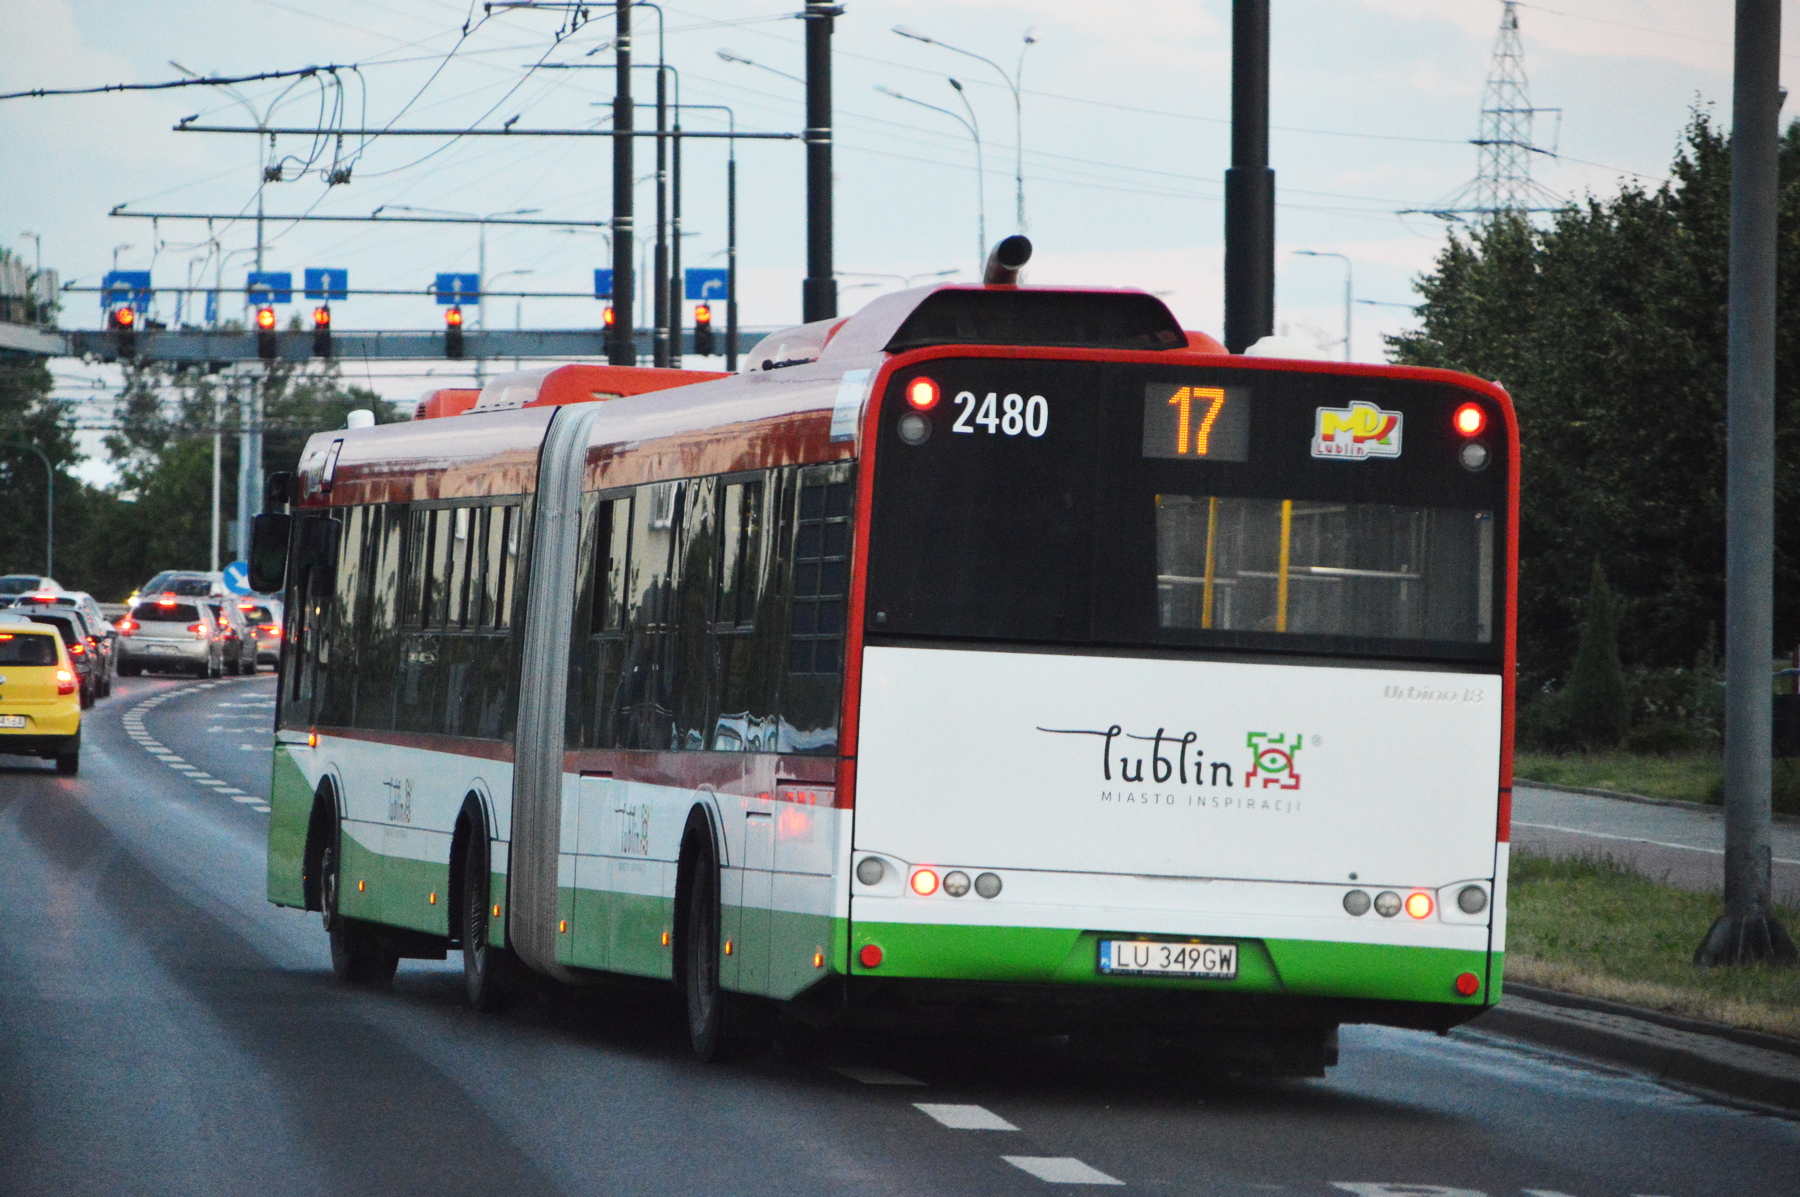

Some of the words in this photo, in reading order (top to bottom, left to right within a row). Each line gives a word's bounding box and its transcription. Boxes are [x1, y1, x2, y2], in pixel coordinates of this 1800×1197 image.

[952, 391, 1049, 437] 2480
[1168, 386, 1225, 455] 17
[1316, 443, 1364, 455] Lublin
[1383, 685, 1458, 702] Urbino
[1463, 688, 1484, 704] 18
[1101, 791, 1175, 805] MIASTO
[1188, 795, 1301, 814] INSPIRACJI
[1117, 944, 1149, 968] LU
[1159, 946, 1232, 971] 349GW
